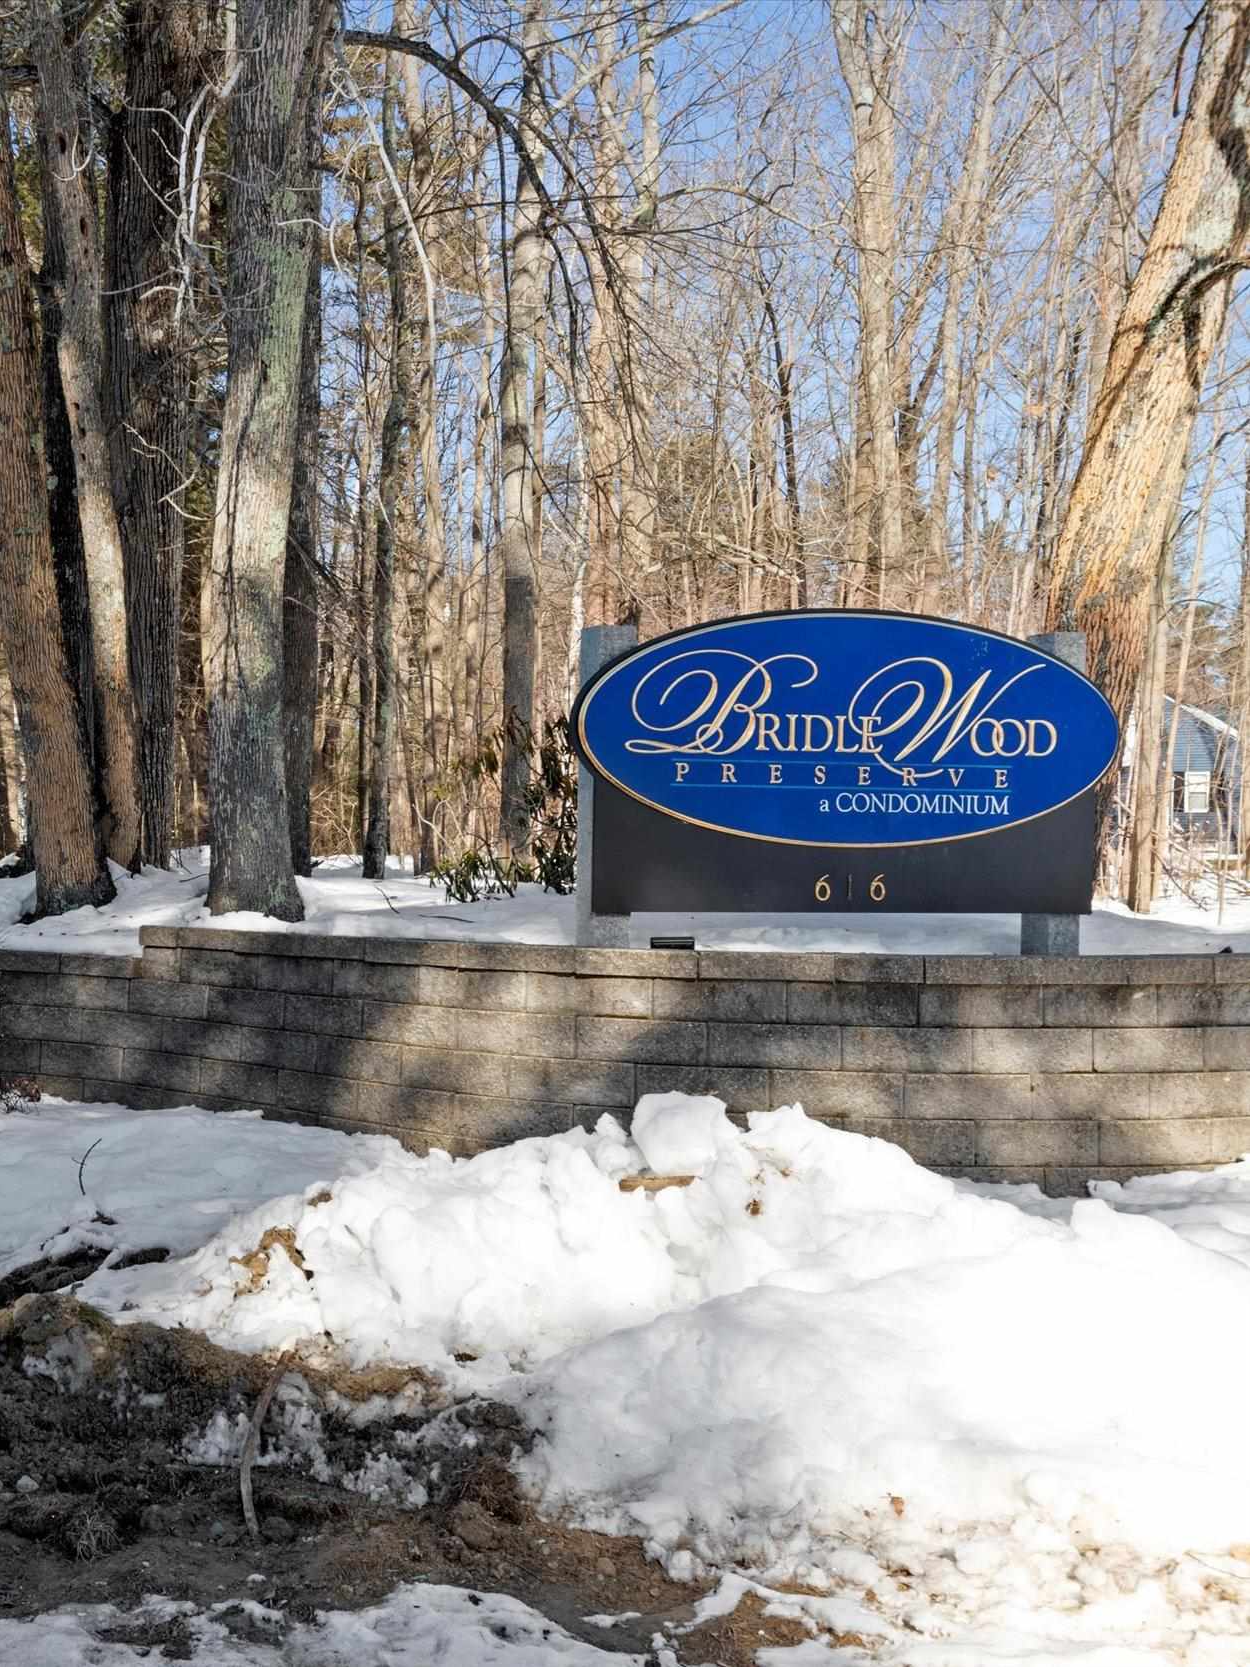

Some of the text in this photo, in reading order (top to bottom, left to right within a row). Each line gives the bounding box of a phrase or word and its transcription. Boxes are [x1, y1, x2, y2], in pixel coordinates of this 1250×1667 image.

[675, 762, 1008, 788] PRESERVE
[820, 792, 1010, 815] a CONDOMINIUM
